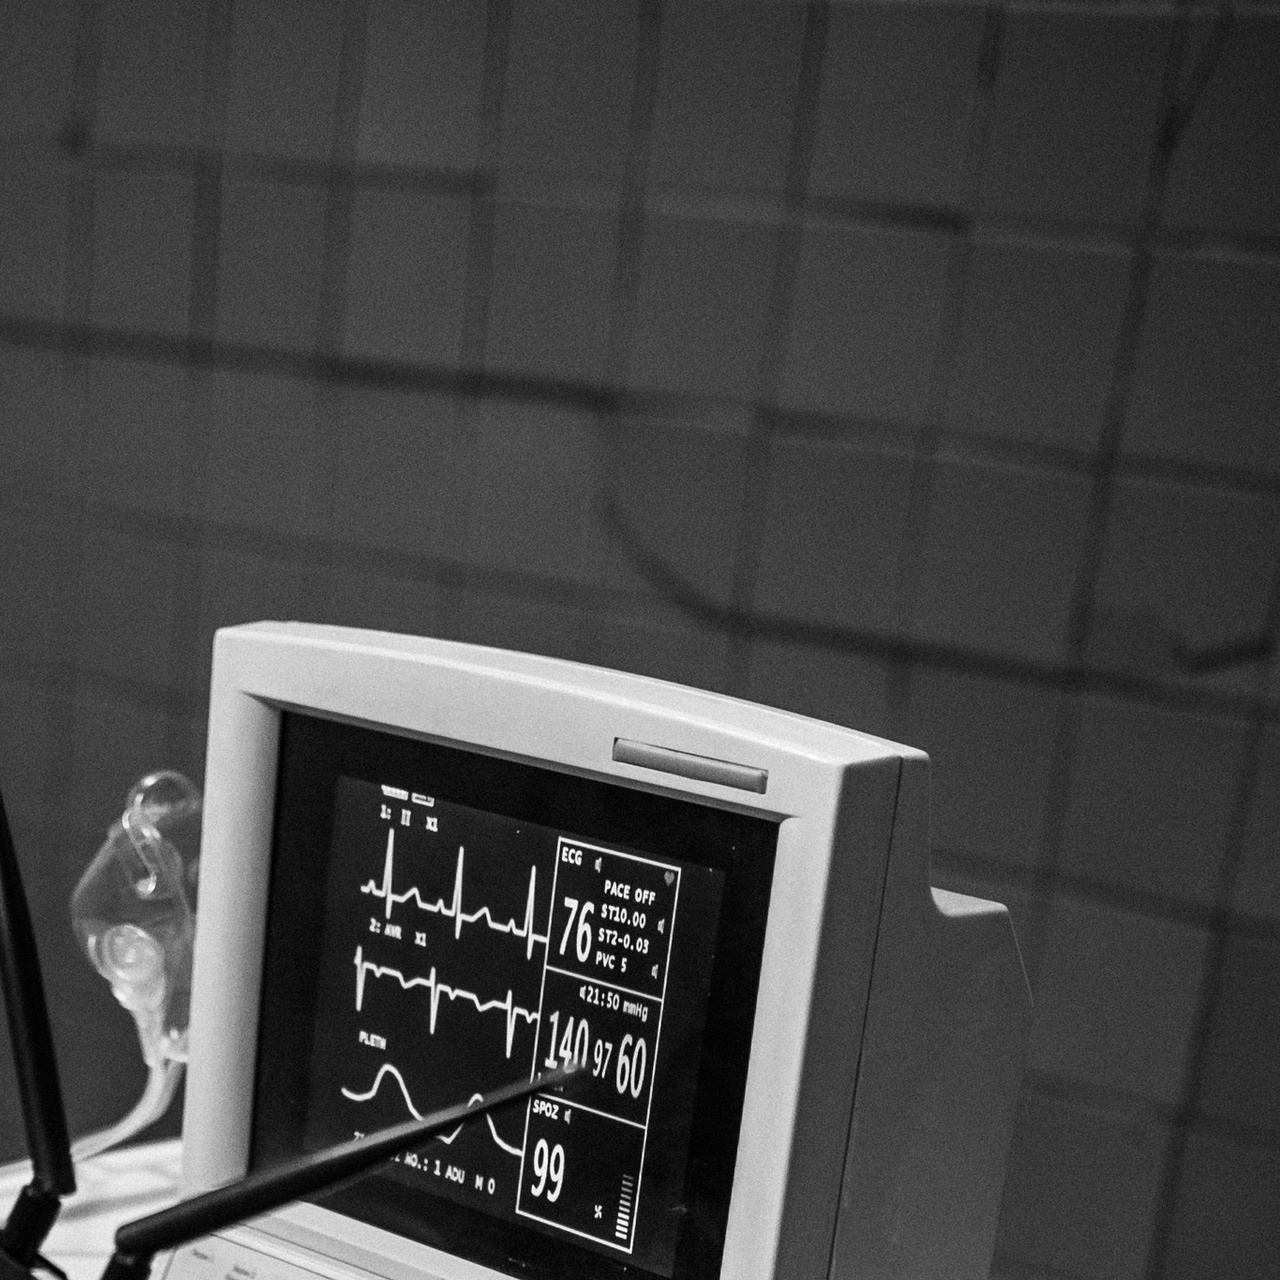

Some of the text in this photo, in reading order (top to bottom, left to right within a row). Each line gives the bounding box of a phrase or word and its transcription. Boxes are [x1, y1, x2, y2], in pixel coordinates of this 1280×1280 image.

[561, 846, 583, 866] ECG
[604, 879, 656, 906] PACE OFF
[559, 896, 595, 963] 76
[595, 951, 628, 973] PVC 5
[586, 985, 648, 1023] 21:50 mmHg
[544, 1010, 647, 1099] 140 97 60
[433, 1159, 441, 1176] 1
[445, 1165, 466, 1184] ADU
[475, 1174, 484, 1191] M
[530, 1138, 565, 1203] 99
